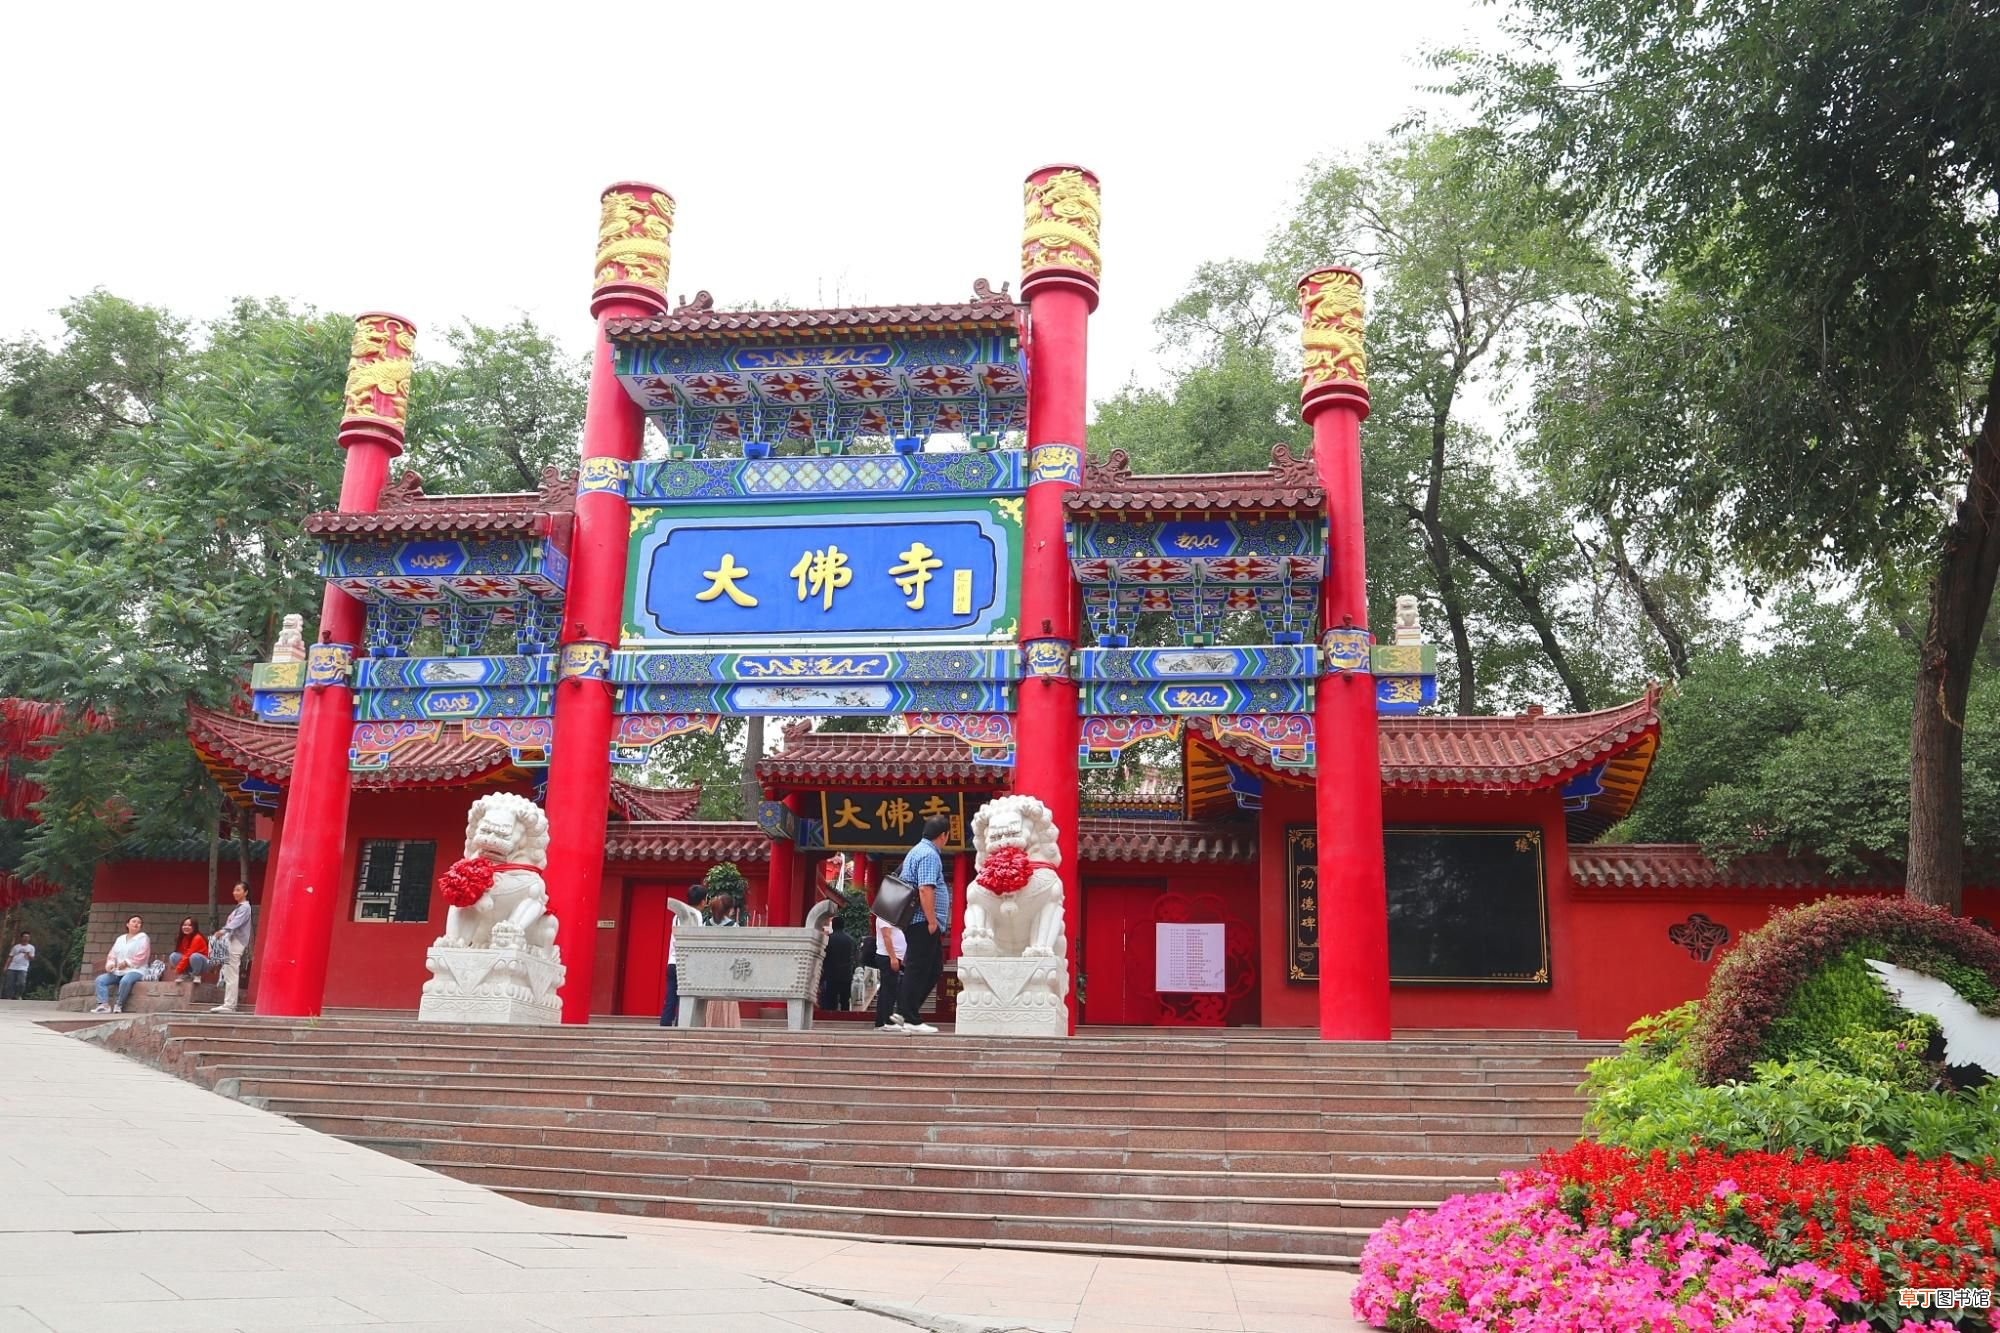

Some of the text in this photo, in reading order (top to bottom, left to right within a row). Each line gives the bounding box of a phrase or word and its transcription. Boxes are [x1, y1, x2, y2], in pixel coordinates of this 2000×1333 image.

[696, 542, 943, 611] 大佛寺
[1300, 877, 1317, 932] 功德碑
[729, 957, 753, 982] 佛
